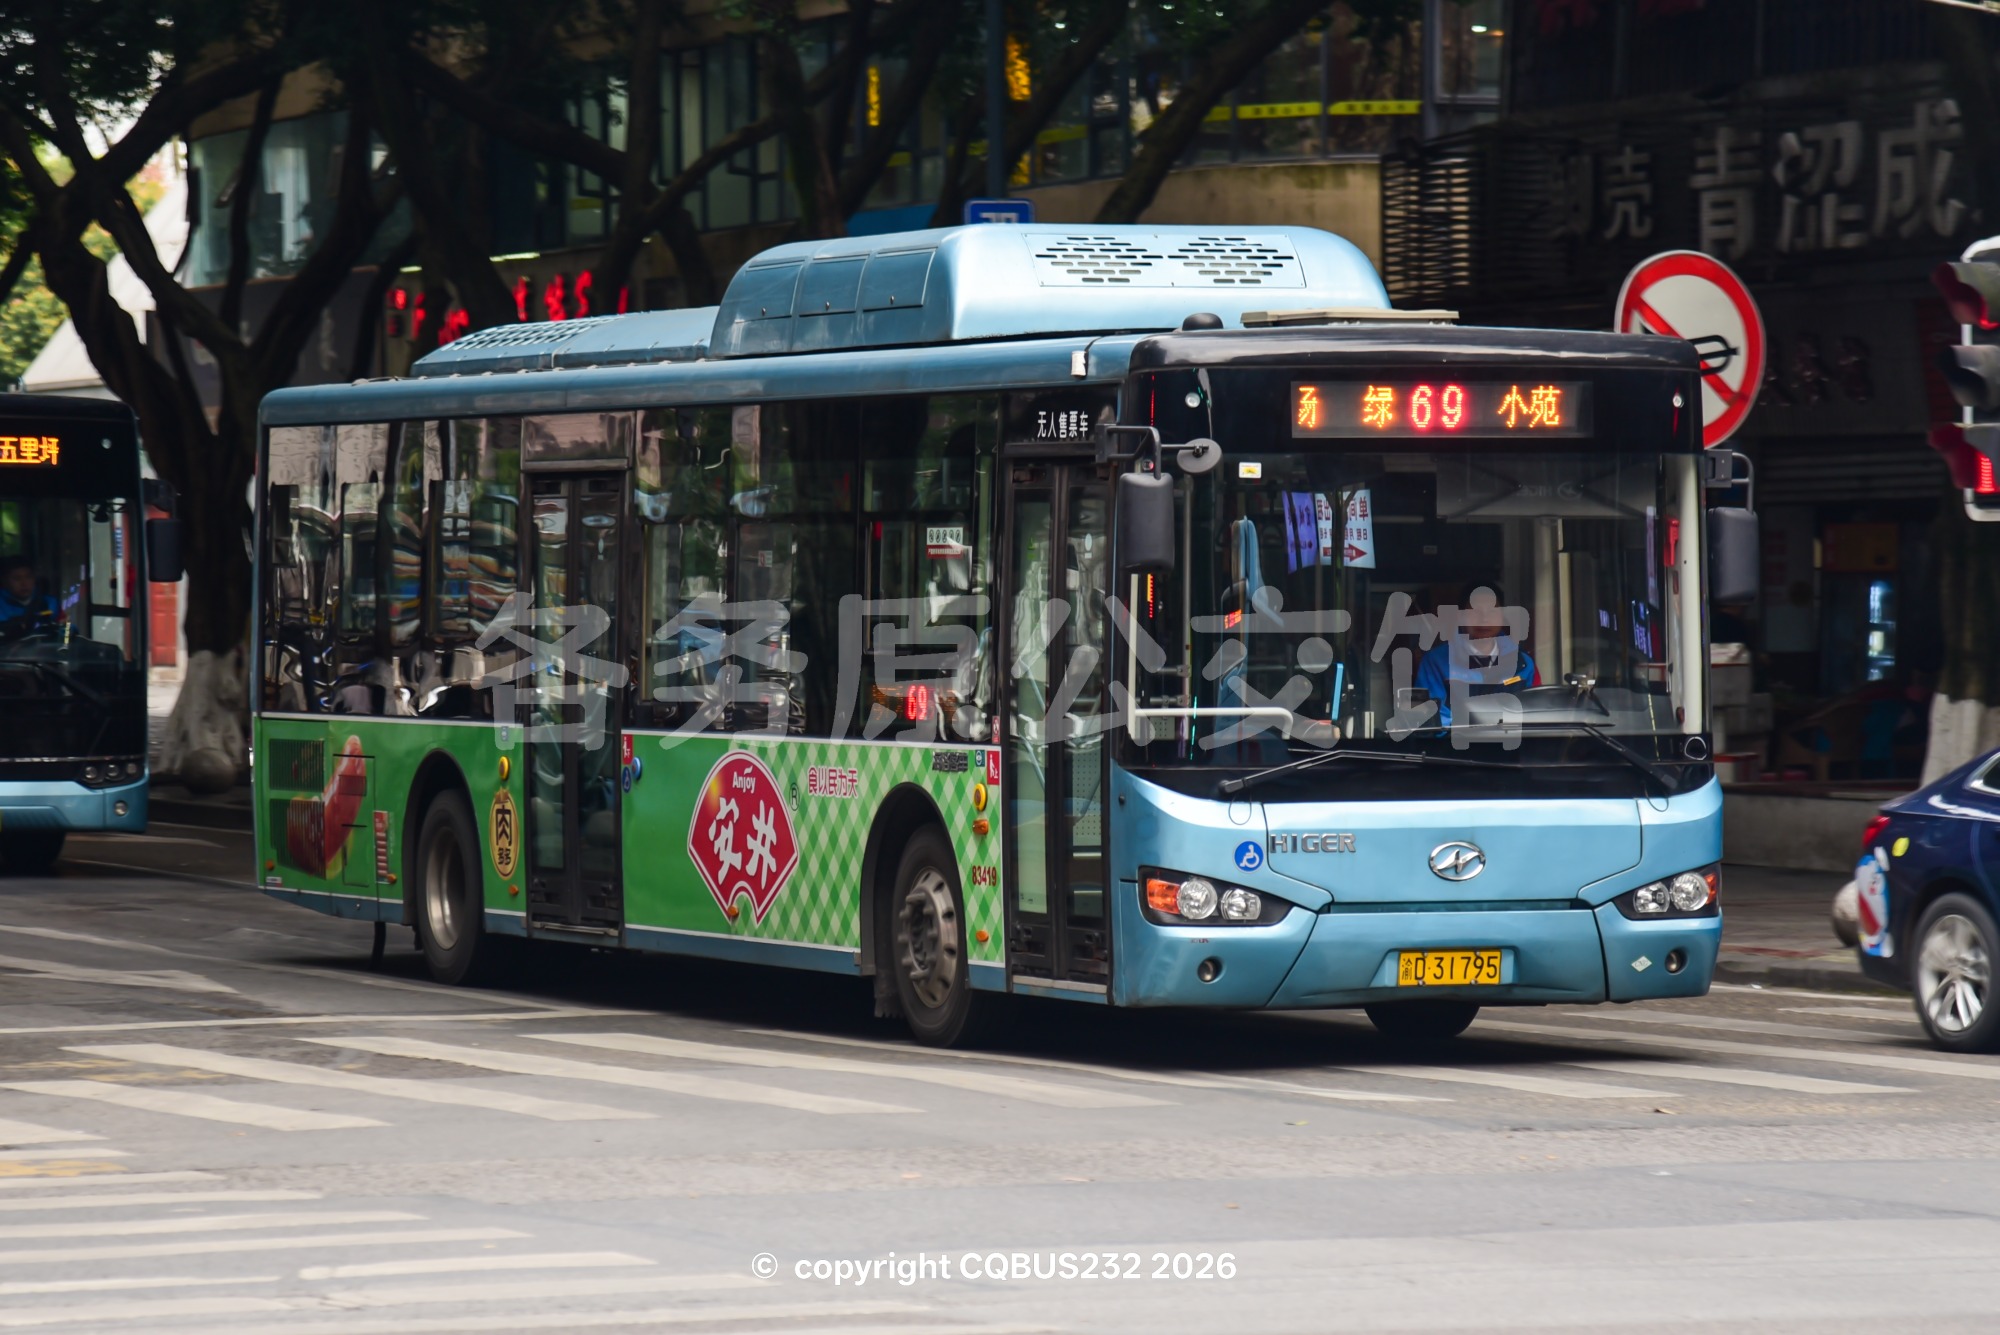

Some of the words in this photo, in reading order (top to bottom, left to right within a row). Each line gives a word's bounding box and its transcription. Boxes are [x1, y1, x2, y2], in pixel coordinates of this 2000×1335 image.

[1363, 385, 1392, 427] 绿
[1412, 385, 1463, 428] 69
[1498, 385, 1562, 428] 小苑
[1037, 410, 1089, 438] 无人售票车
[0, 436, 59, 465] 五里坪
[908, 684, 927, 720] 69
[732, 769, 756, 794] Anjoy
[808, 766, 859, 797] 食以民为天
[708, 797, 777, 890] 安井
[1269, 833, 1356, 853] HIGER
[972, 865, 997, 887] 83419
